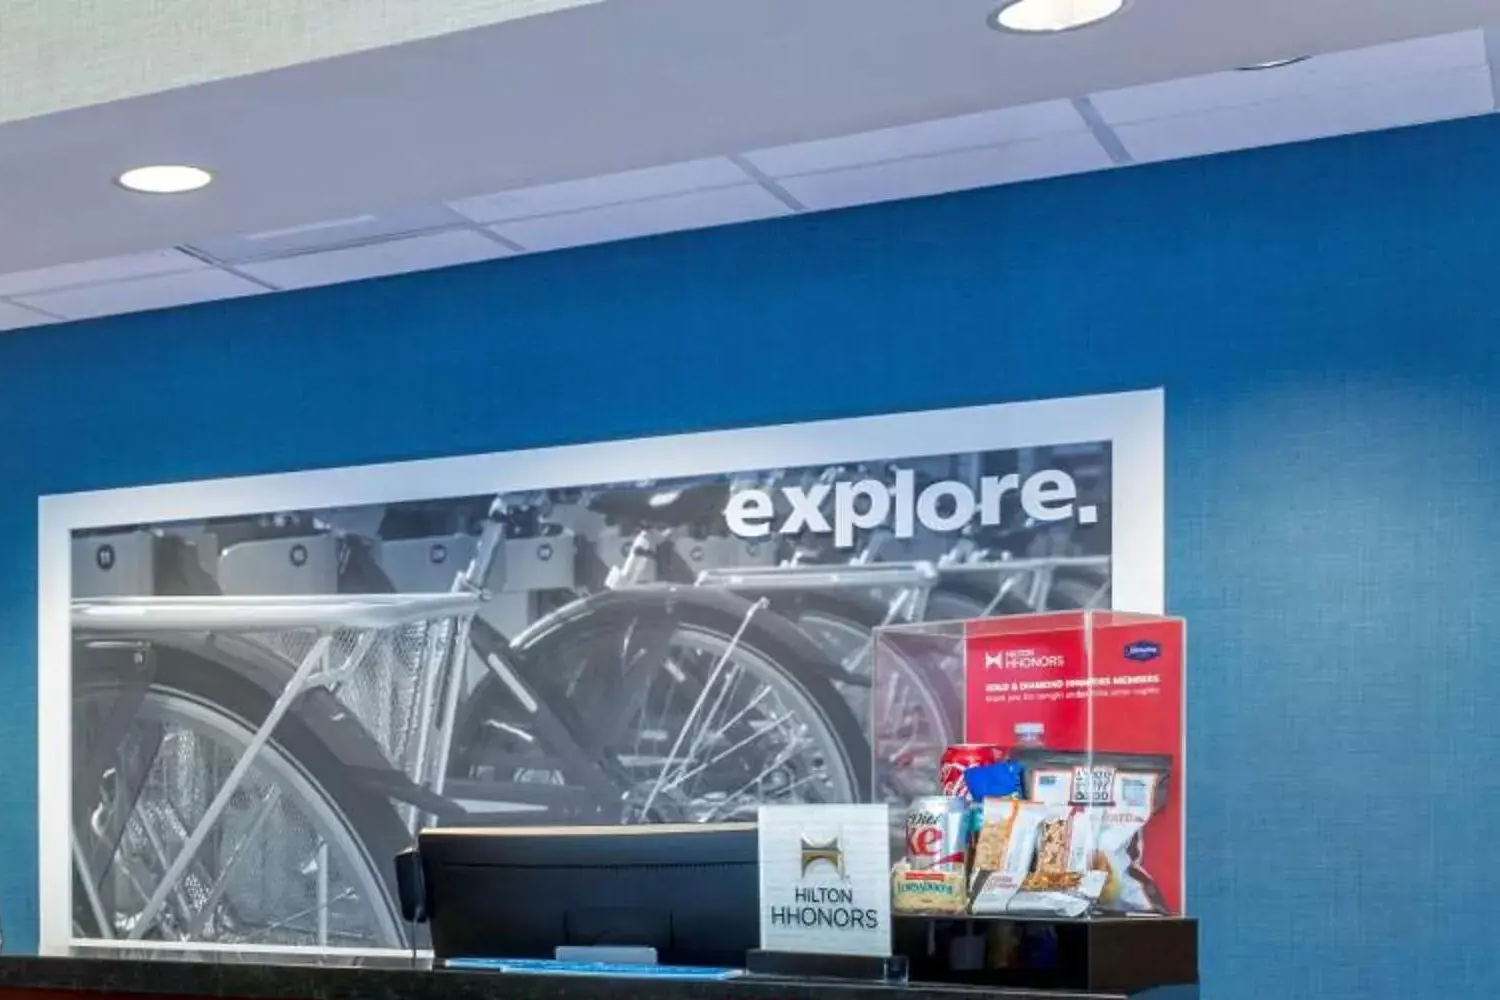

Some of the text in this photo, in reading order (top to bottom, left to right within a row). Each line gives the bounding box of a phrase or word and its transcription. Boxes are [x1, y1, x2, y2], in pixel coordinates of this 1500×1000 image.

[724, 467, 1098, 548] explore.
[795, 887, 853, 904] HILTON
[771, 906, 879, 930] HHONORS
